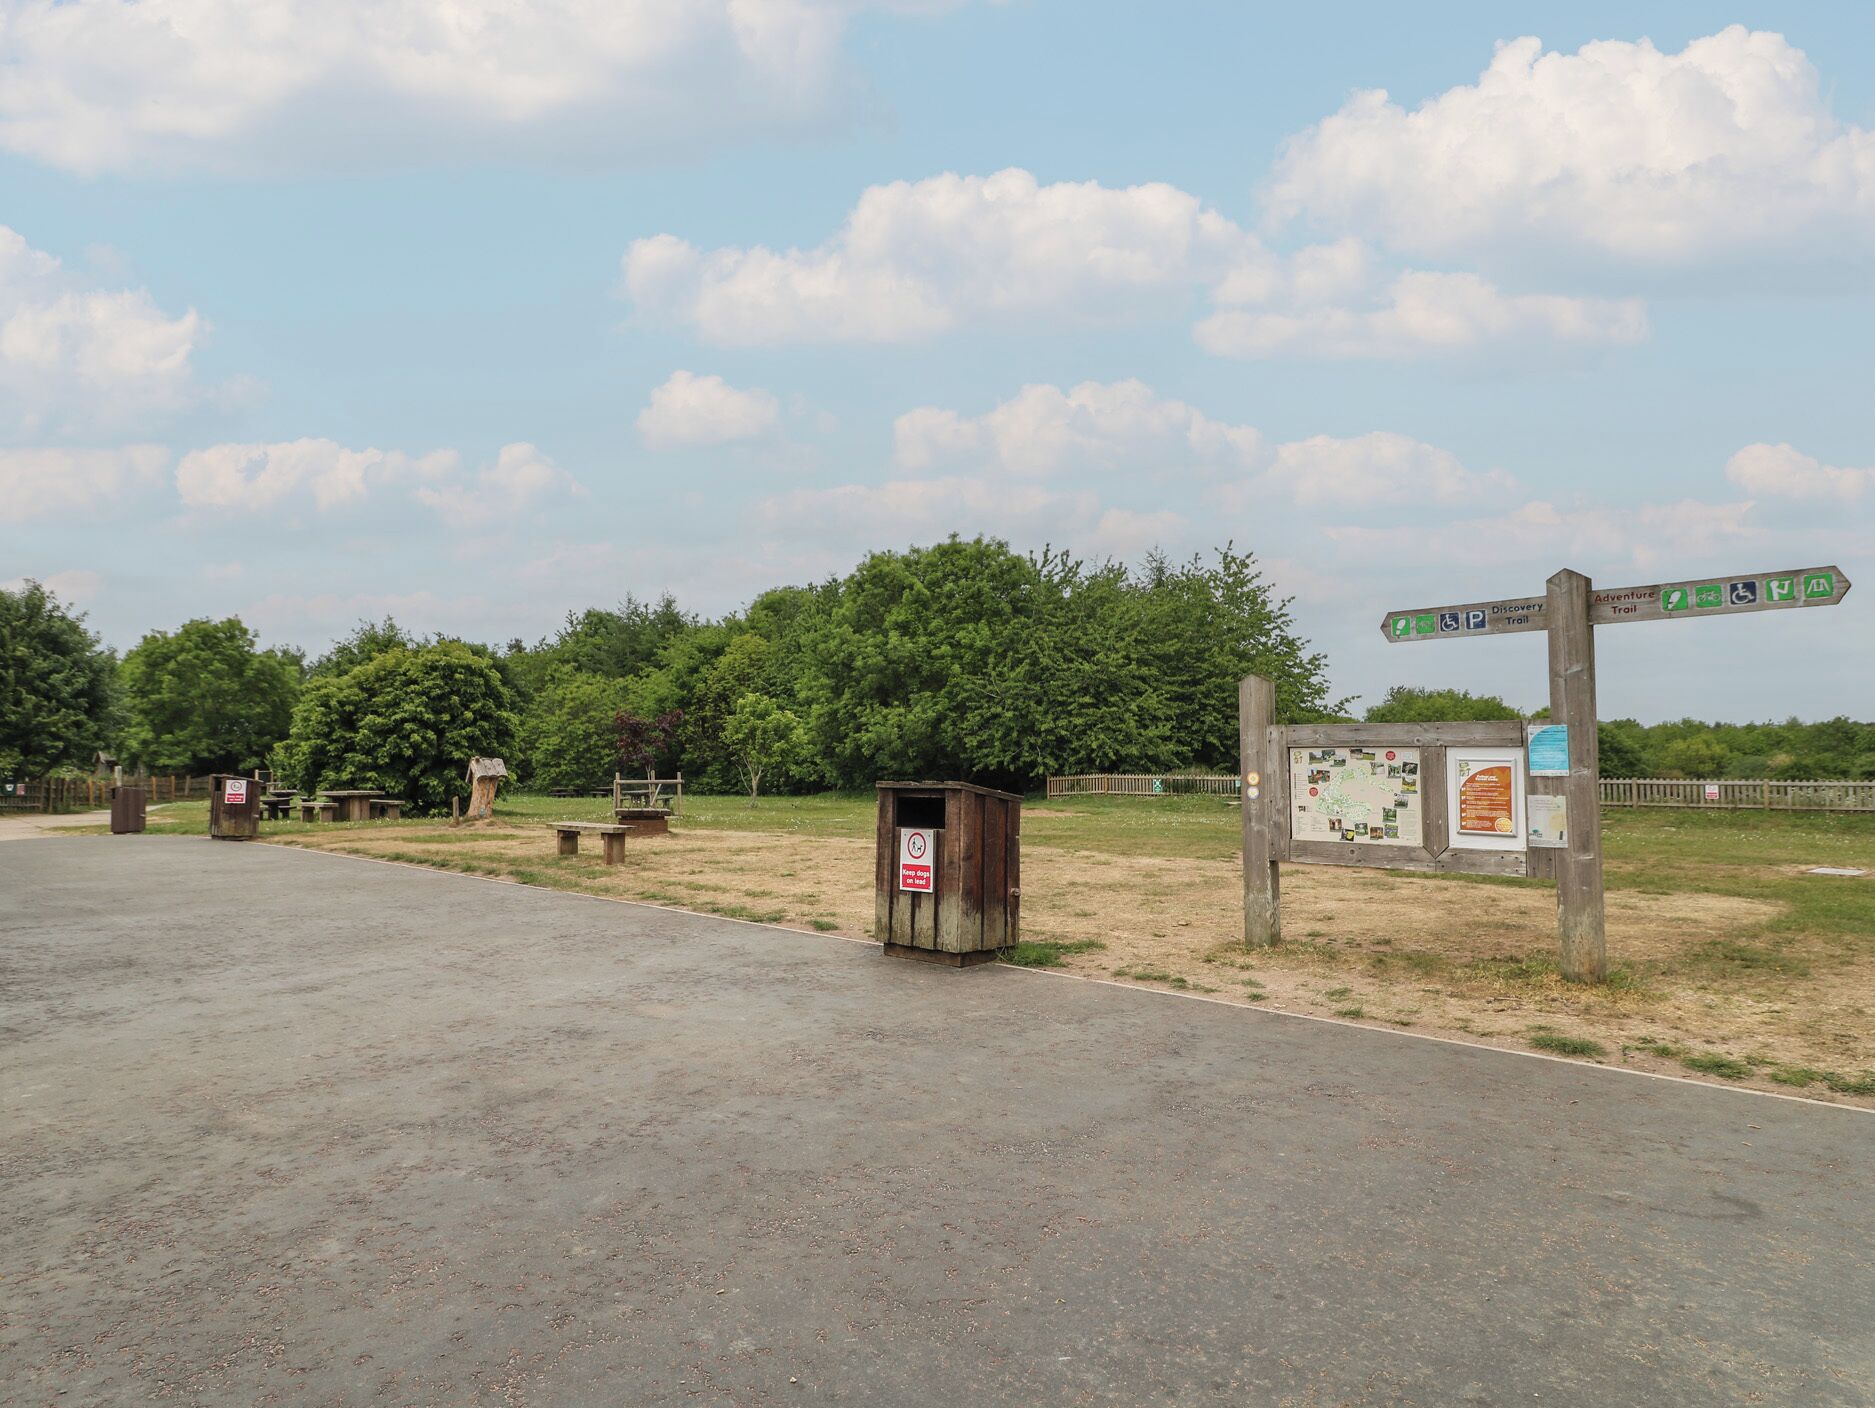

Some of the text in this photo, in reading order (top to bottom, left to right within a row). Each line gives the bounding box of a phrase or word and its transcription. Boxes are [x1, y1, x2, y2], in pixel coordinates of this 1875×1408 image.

[1595, 591, 1655, 603] Adventure
[1492, 603, 1543, 614] Discovery
[1611, 604, 1637, 615] Trail
[1469, 611, 1483, 629] P
[1505, 615, 1529, 625] Trail
[903, 869, 930, 878] Keep dogs
